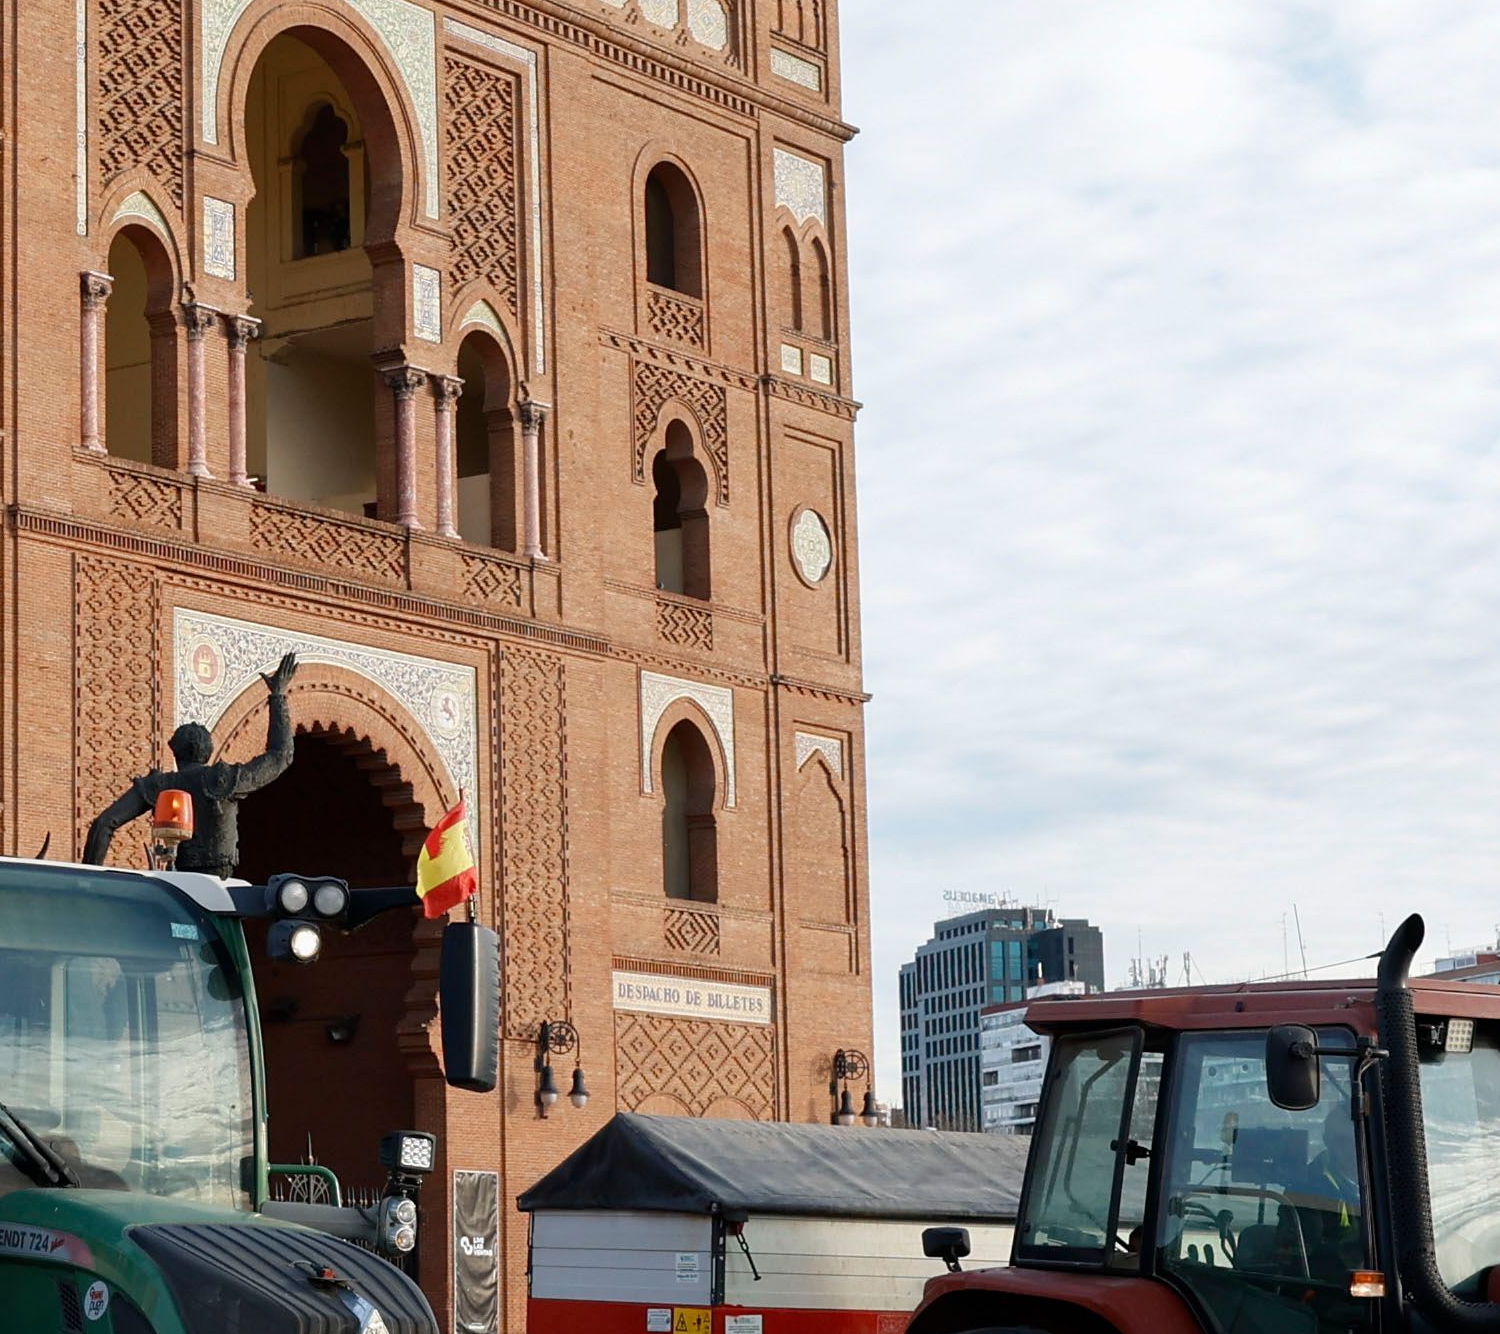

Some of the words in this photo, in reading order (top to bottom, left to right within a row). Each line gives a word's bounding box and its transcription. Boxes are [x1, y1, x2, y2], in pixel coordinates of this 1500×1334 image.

[618, 983, 680, 1004] DESPACHO
[686, 990, 701, 1005] DE
[708, 993, 763, 1013] BILLETES
[29, 1233, 49, 1252] 724
